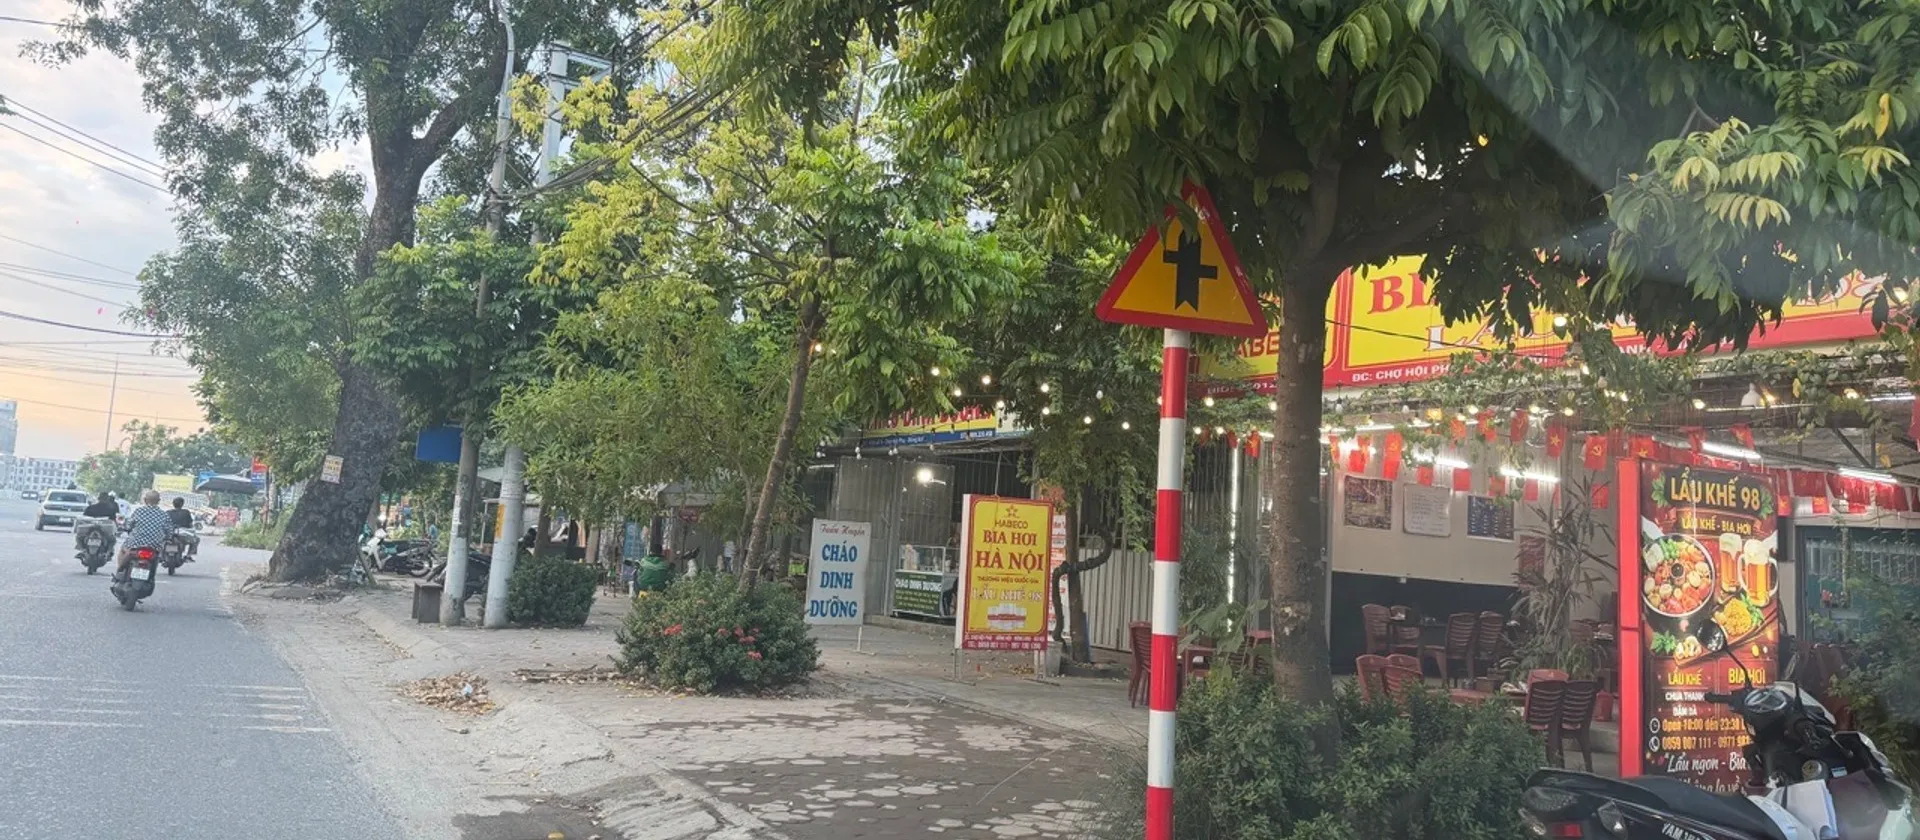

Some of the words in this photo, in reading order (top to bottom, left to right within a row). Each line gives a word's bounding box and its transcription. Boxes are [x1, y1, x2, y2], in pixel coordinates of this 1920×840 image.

[1367, 271, 1437, 315] BI
[1352, 372, 1373, 383] ĐC:
[1376, 369, 1402, 380] CHỢ
[1405, 365, 1428, 377] HỘI
[1431, 363, 1450, 375] PH
[1671, 466, 1702, 503] LẨU
[1706, 476, 1738, 507] KHẾ
[1741, 486, 1761, 511] 98
[995, 519, 1029, 529] HABECO
[1701, 515, 1715, 531] KHẾ
[1722, 520, 1735, 532] BIA
[983, 530, 1008, 545] BIA
[1011, 531, 1038, 546] HƠI
[821, 540, 858, 562] CHÁO
[975, 547, 1004, 570] HÀ
[1008, 549, 1045, 574] NỘI
[819, 571, 853, 590] DINH
[809, 595, 858, 617] DƯỠNG
[1668, 668, 1685, 685] LẨU
[1686, 669, 1702, 685] KHẾ
[1728, 668, 1746, 684] BIA
[1698, 736, 1712, 749] 111
[1692, 758, 1719, 776] ngon
[1729, 751, 1746, 771] Bia
